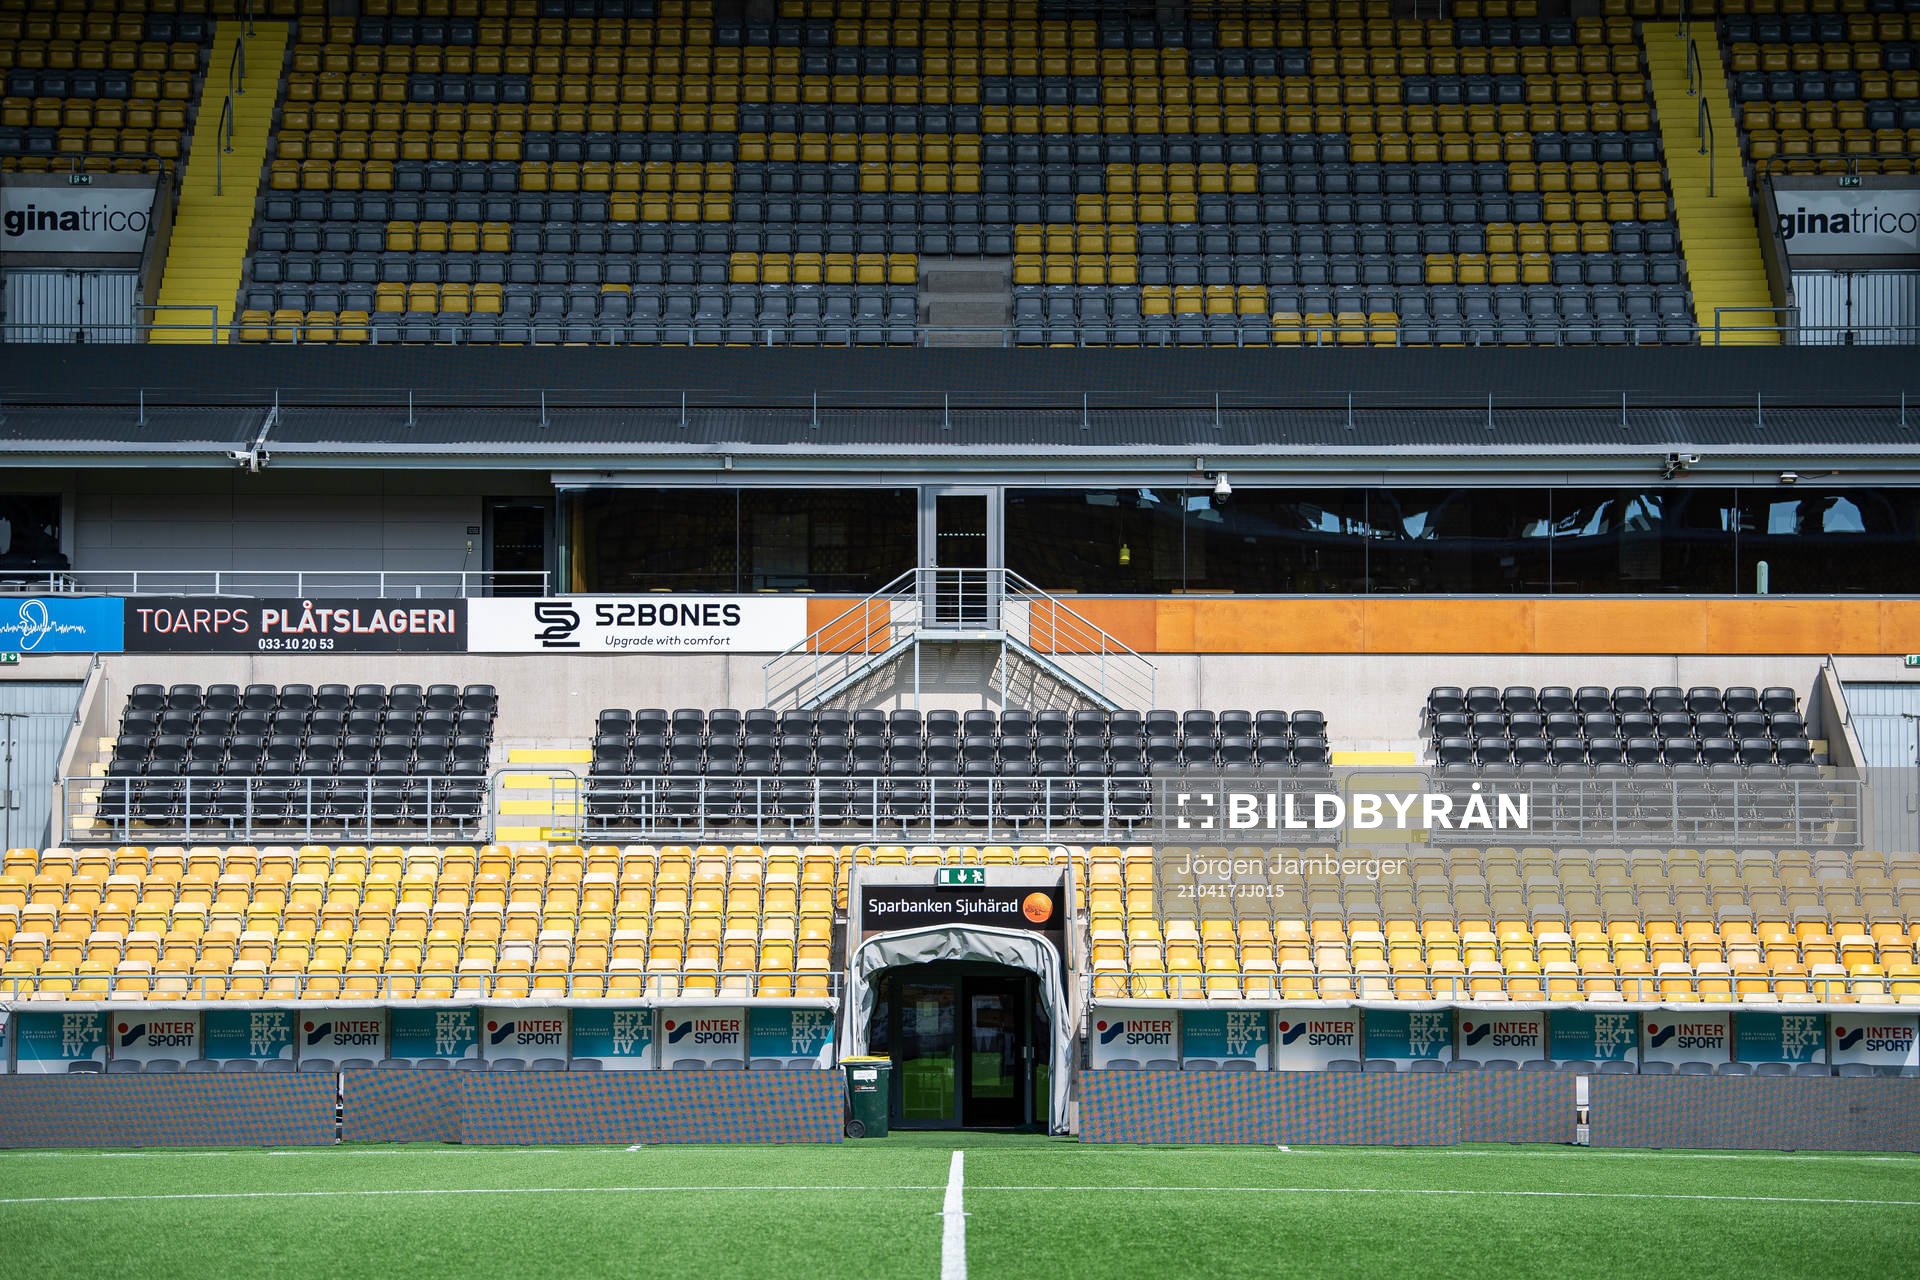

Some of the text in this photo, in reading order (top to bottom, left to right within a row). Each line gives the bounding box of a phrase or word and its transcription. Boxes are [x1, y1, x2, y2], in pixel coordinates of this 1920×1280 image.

[1778, 206, 1920, 240] ginatrico
[136, 601, 456, 634] TOARPS PLÅTSLAGERI
[595, 603, 740, 627] 52BONES
[258, 638, 335, 650] 033-10 20 53
[604, 634, 731, 648] Upgrade with comfort
[868, 898, 1019, 919] Sparbanken Sjuhärad
[63, 1014, 98, 1027] EFF
[251, 1014, 285, 1026] EFF
[436, 1013, 470, 1025] EFF
[614, 1012, 647, 1024] EFF
[792, 1012, 825, 1025] EFF
[1227, 1013, 1260, 1025] EFF
[1409, 1012, 1443, 1027] EFF
[1595, 1016, 1629, 1028] EFF
[1782, 1017, 1816, 1030] EFF
[150, 1021, 194, 1035] INTER
[335, 1021, 379, 1033] INTER
[518, 1020, 562, 1032] INTER
[695, 1019, 739, 1032] INTER
[1127, 1020, 1171, 1033] INTER
[1308, 1021, 1354, 1034] INTER
[1493, 1023, 1538, 1034] INTER
[1678, 1024, 1723, 1037] INTER
[517, 1033, 562, 1044] SPORT
[695, 1032, 739, 1044] SPORT
[1127, 1033, 1171, 1044] SPORT
[1866, 1026, 1913, 1040] INTER
[148, 1035, 194, 1047] SPORT
[334, 1034, 379, 1045] SPORT
[1309, 1034, 1354, 1045] SPORT
[1493, 1034, 1538, 1046] SPORT
[1678, 1037, 1724, 1048] SPORT
